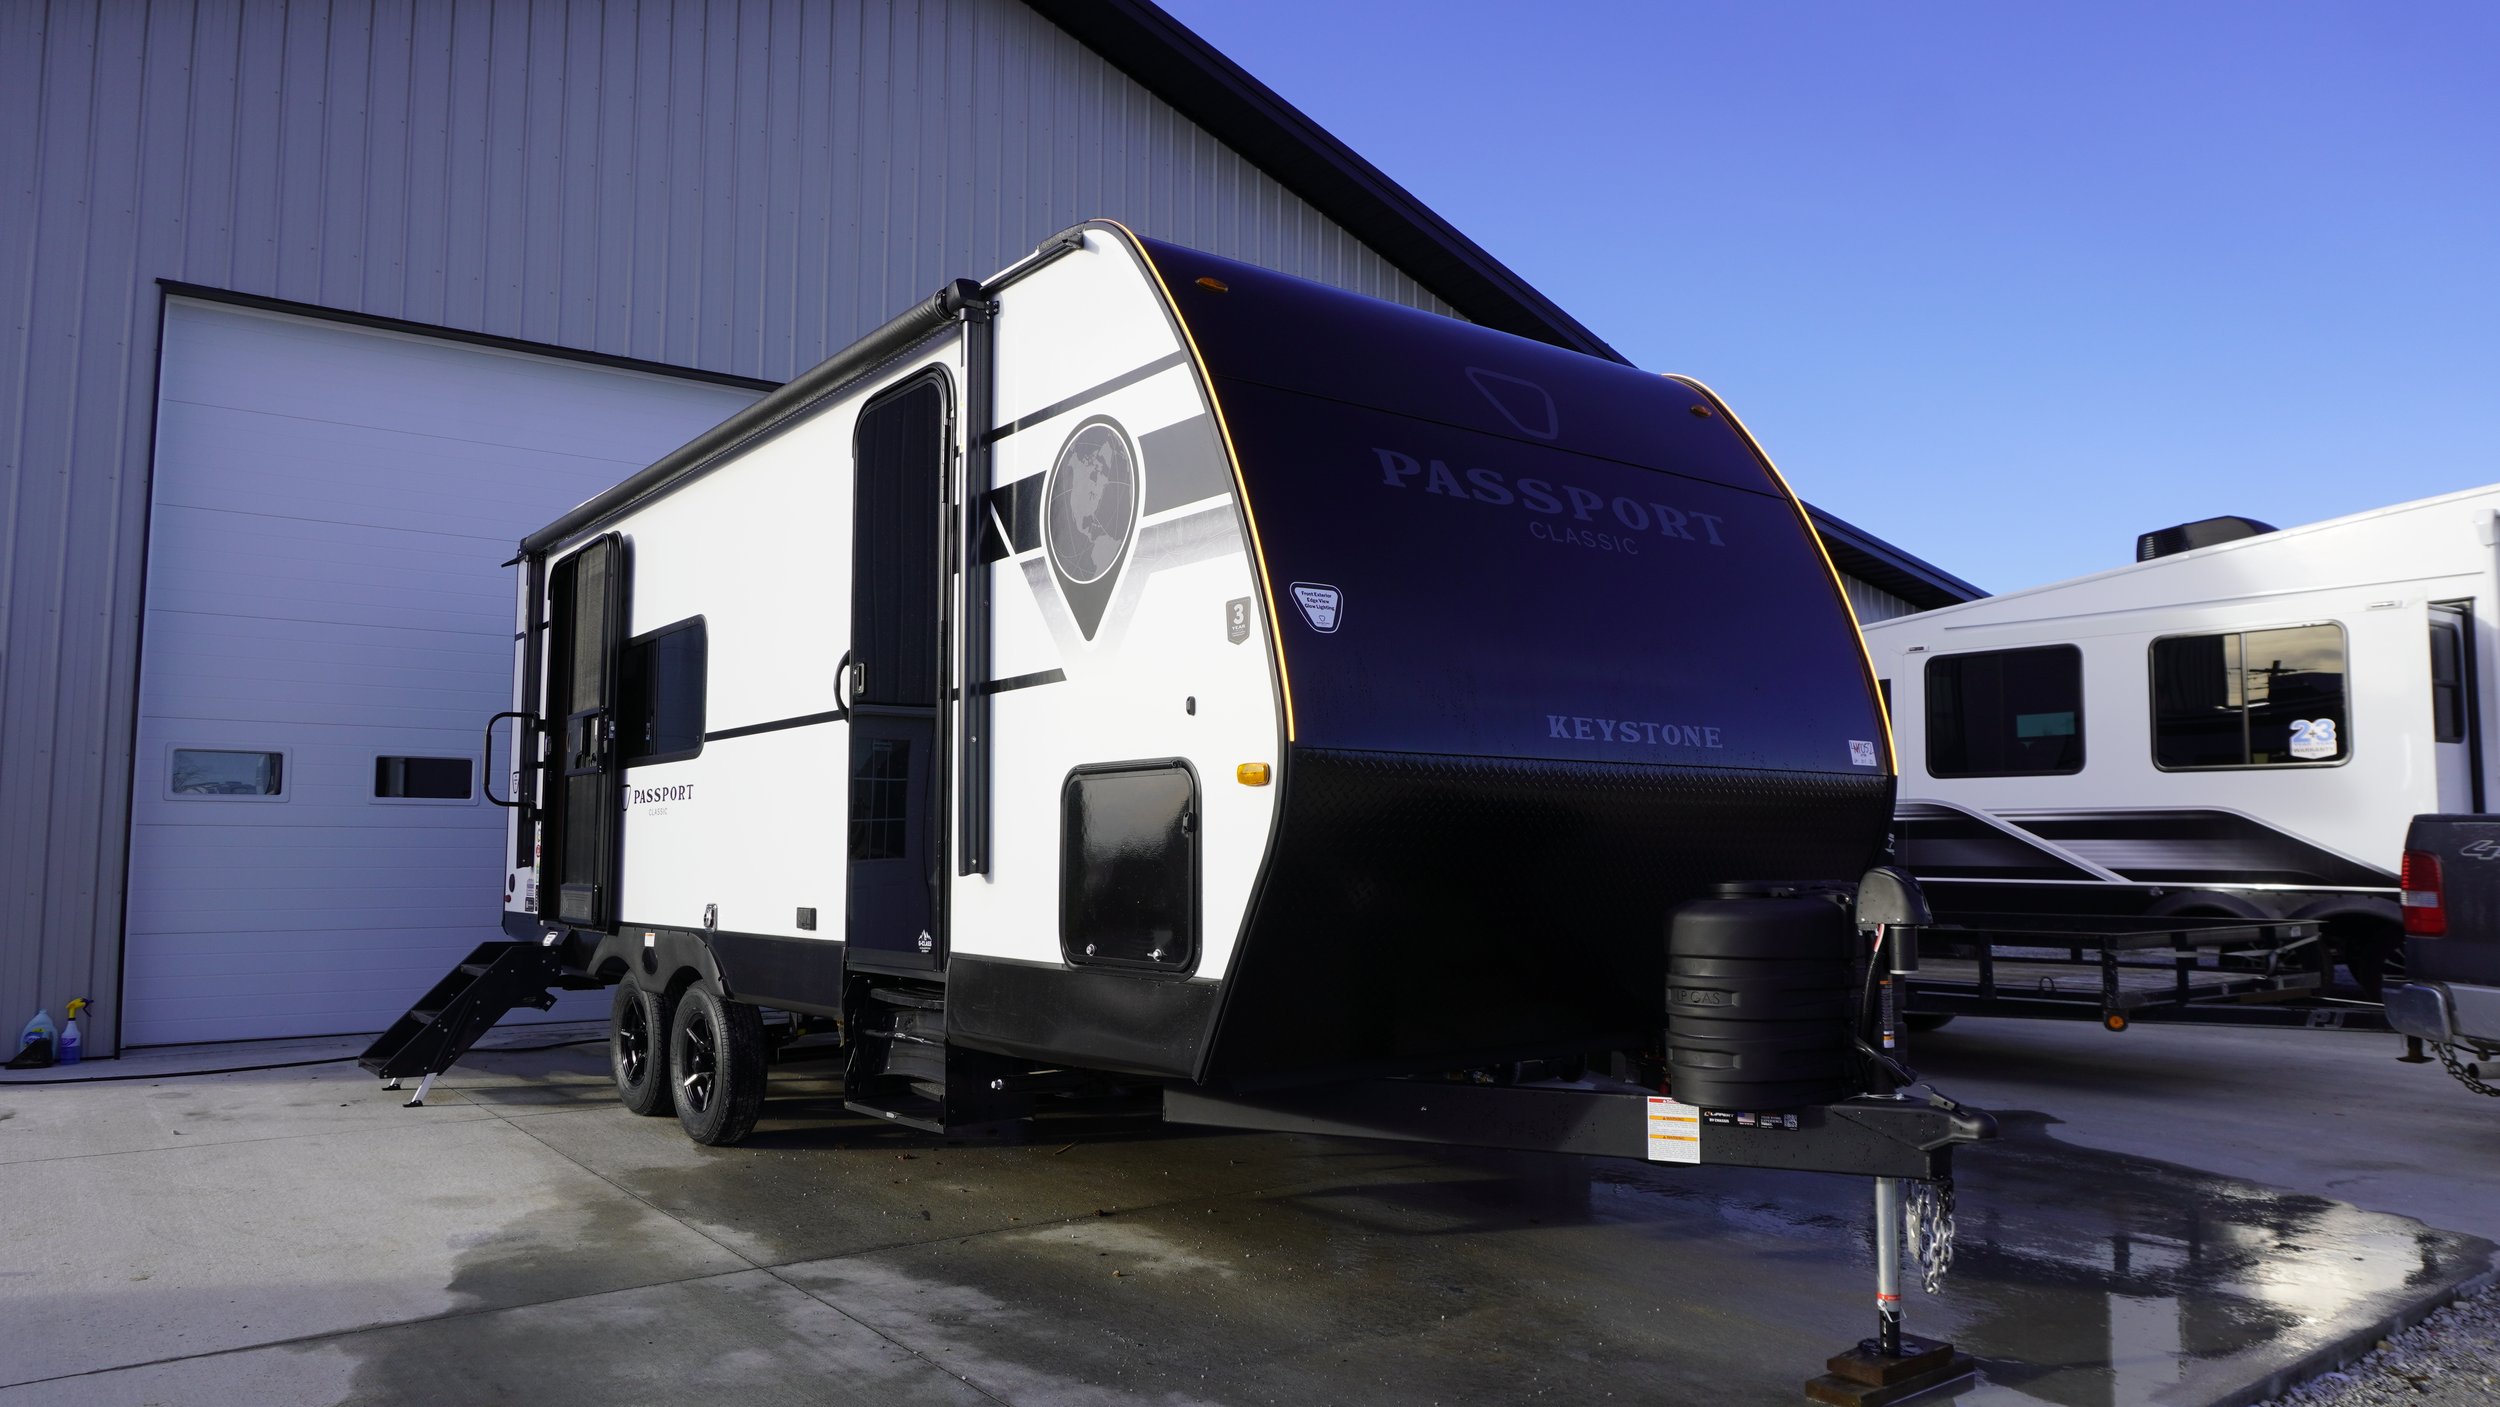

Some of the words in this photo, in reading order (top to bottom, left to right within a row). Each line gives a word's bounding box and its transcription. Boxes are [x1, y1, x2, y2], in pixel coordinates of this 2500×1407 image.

[1371, 447, 1726, 547] PASSPORT
[1529, 521, 1639, 555] CLASSIC
[1233, 603, 1244, 625] 3
[1546, 714, 1724, 749] KEYSTONE
[633, 784, 694, 805] PASSPORT
[648, 807, 668, 817] CLASSIC
